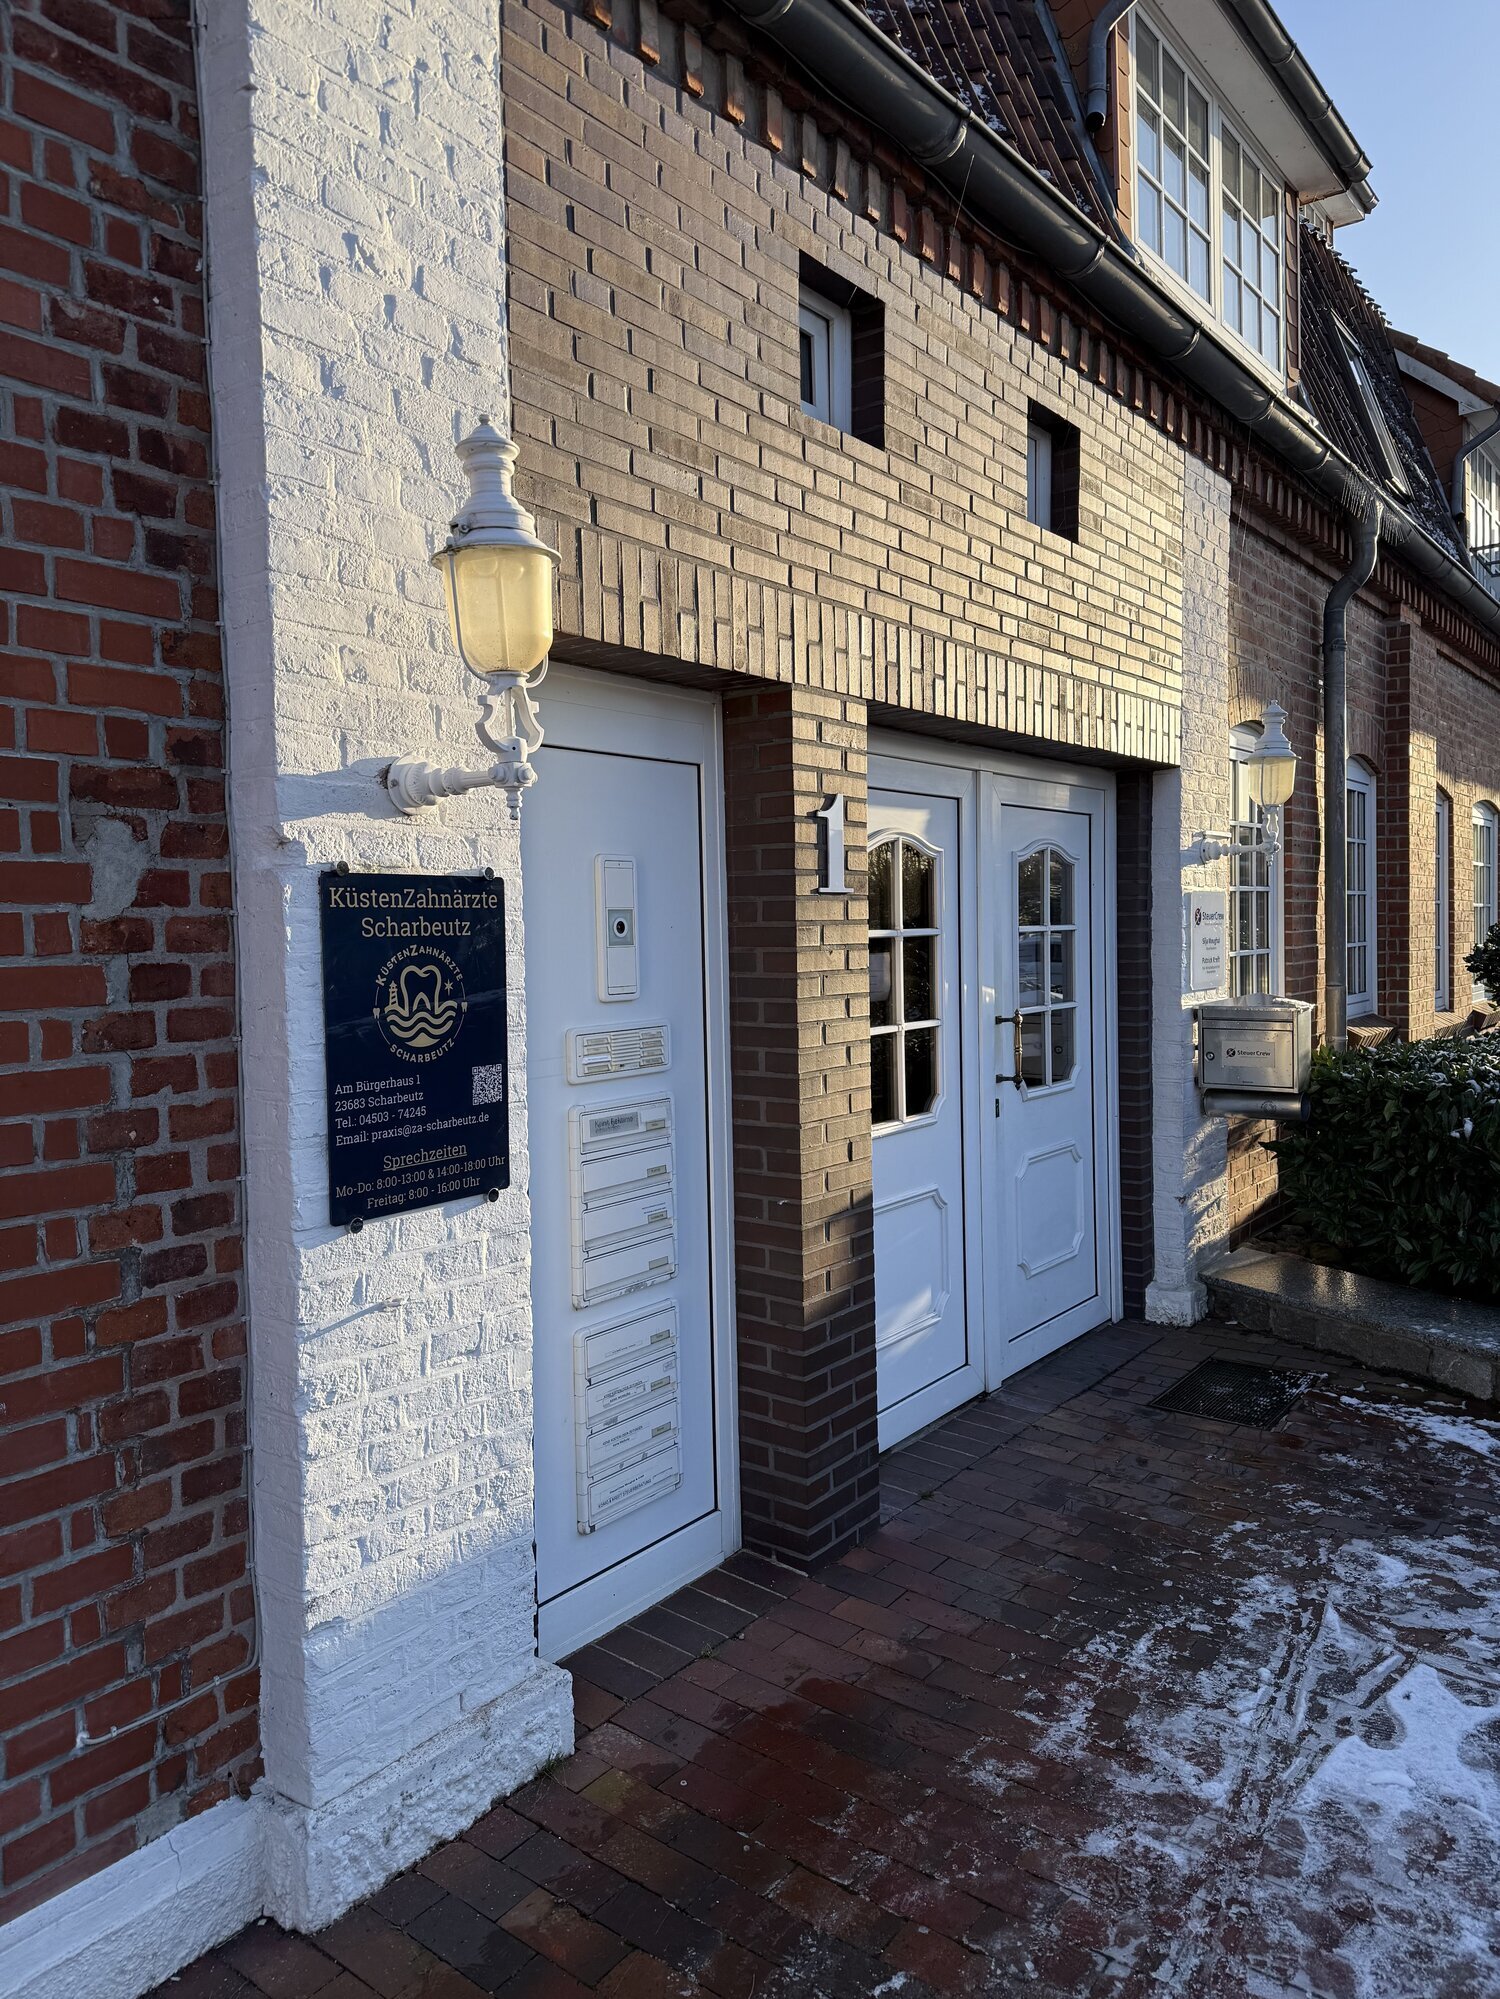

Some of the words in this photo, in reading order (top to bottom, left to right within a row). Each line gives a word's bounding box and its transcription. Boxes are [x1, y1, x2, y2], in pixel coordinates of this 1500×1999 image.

[817, 793, 854, 893] 1
[329, 887, 498, 909] KüstenZahnärzte
[361, 916, 471, 937] Scharbeutz
[389, 1038, 455, 1063] SCHARBEUTZ
[334, 1083, 353, 1095] Am
[356, 1077, 414, 1093] Bürgerhaus
[416, 1075, 421, 1084] 1
[335, 1098, 366, 1112] 23683
[368, 1091, 424, 1107] Scharbeutz
[335, 1117, 357, 1129] Tel.:
[359, 1112, 389, 1126] 04503
[398, 1106, 427, 1119] 74245
[336, 1130, 369, 1146] Email:
[371, 1112, 490, 1143] praxis@za-scharbeutz.de
[383, 1144, 467, 1171] Sprechzeiten
[336, 1182, 374, 1198] Mo-Do:
[376, 1171, 426, 1189] 8:00-13:00
[427, 1169, 435, 1179] &
[437, 1158, 486, 1178] 14:00-18:00
[488, 1155, 506, 1167] Uhr
[367, 1193, 407, 1209] Freitag:
[408, 1187, 429, 1200] 8:00
[437, 1179, 461, 1194] 16:00
[463, 1176, 481, 1188] Uhr
